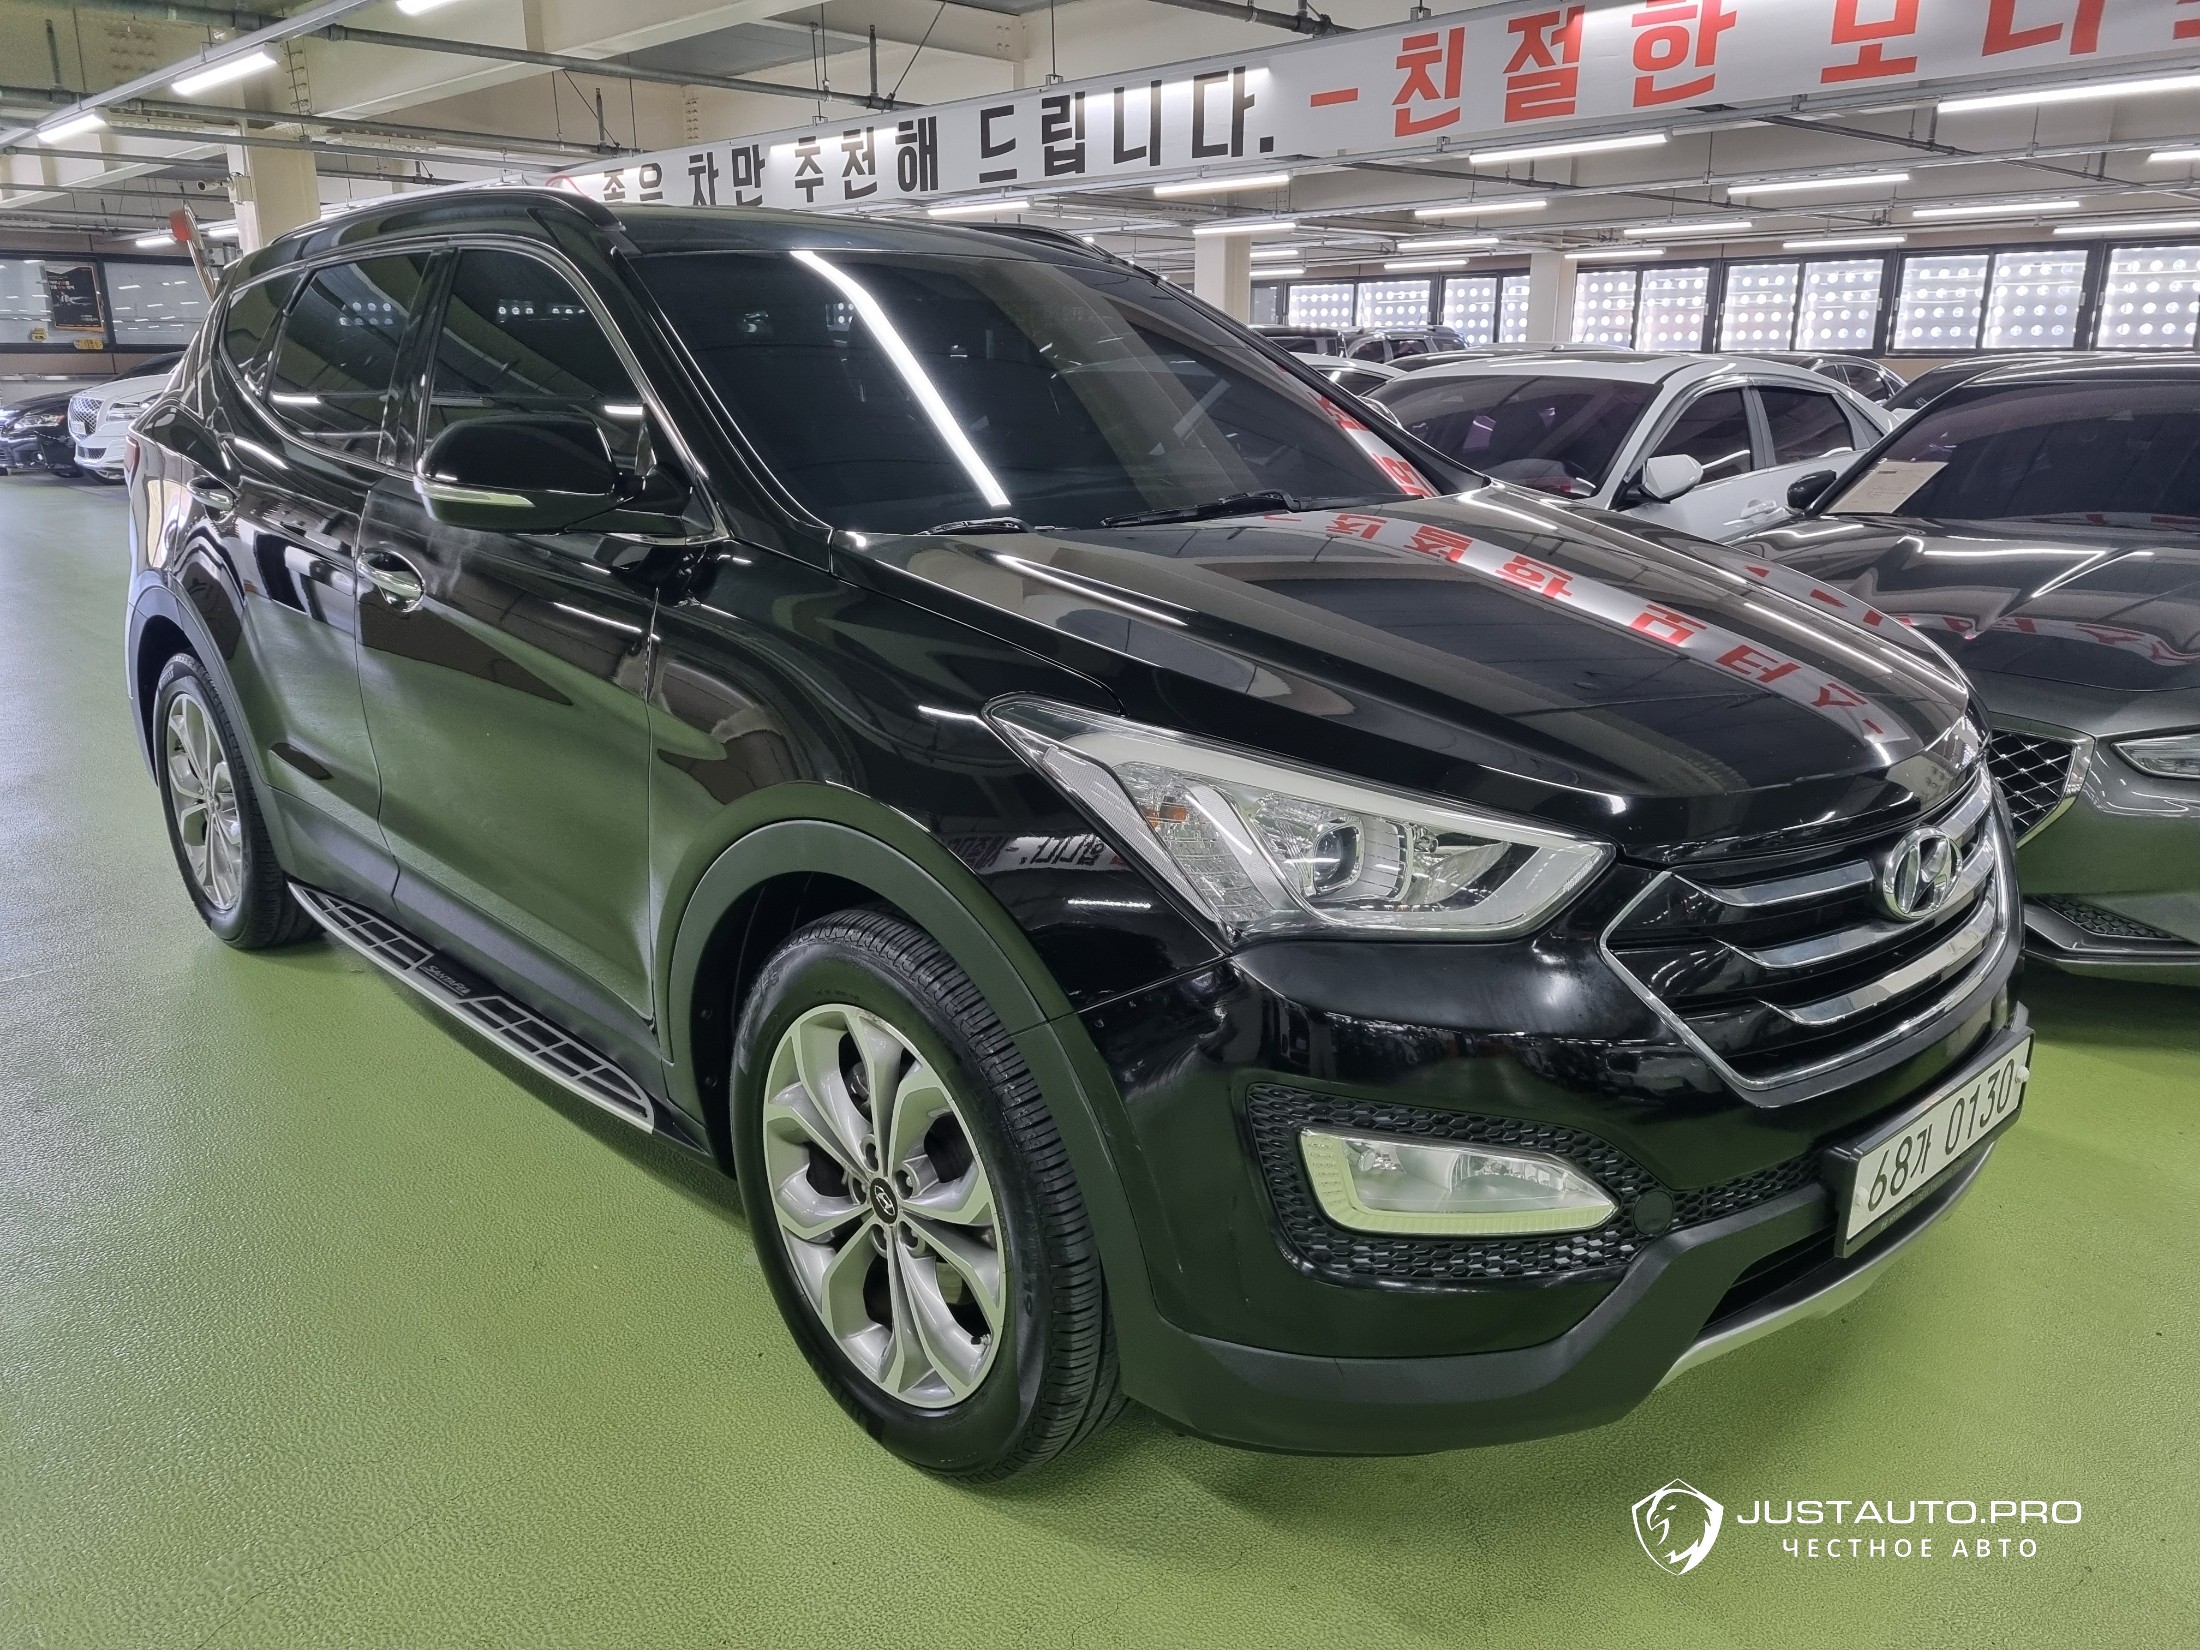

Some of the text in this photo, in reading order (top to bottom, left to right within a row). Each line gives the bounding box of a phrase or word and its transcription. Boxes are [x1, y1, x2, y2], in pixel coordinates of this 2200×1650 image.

[688, 144, 766, 205] 차만
[793, 115, 938, 203] 추천해
[980, 66, 1275, 183] 드립니다.
[1392, 0, 1736, 138] 친절한
[1867, 1123, 1933, 1212] 68가
[1945, 1058, 2015, 1156] 0130
